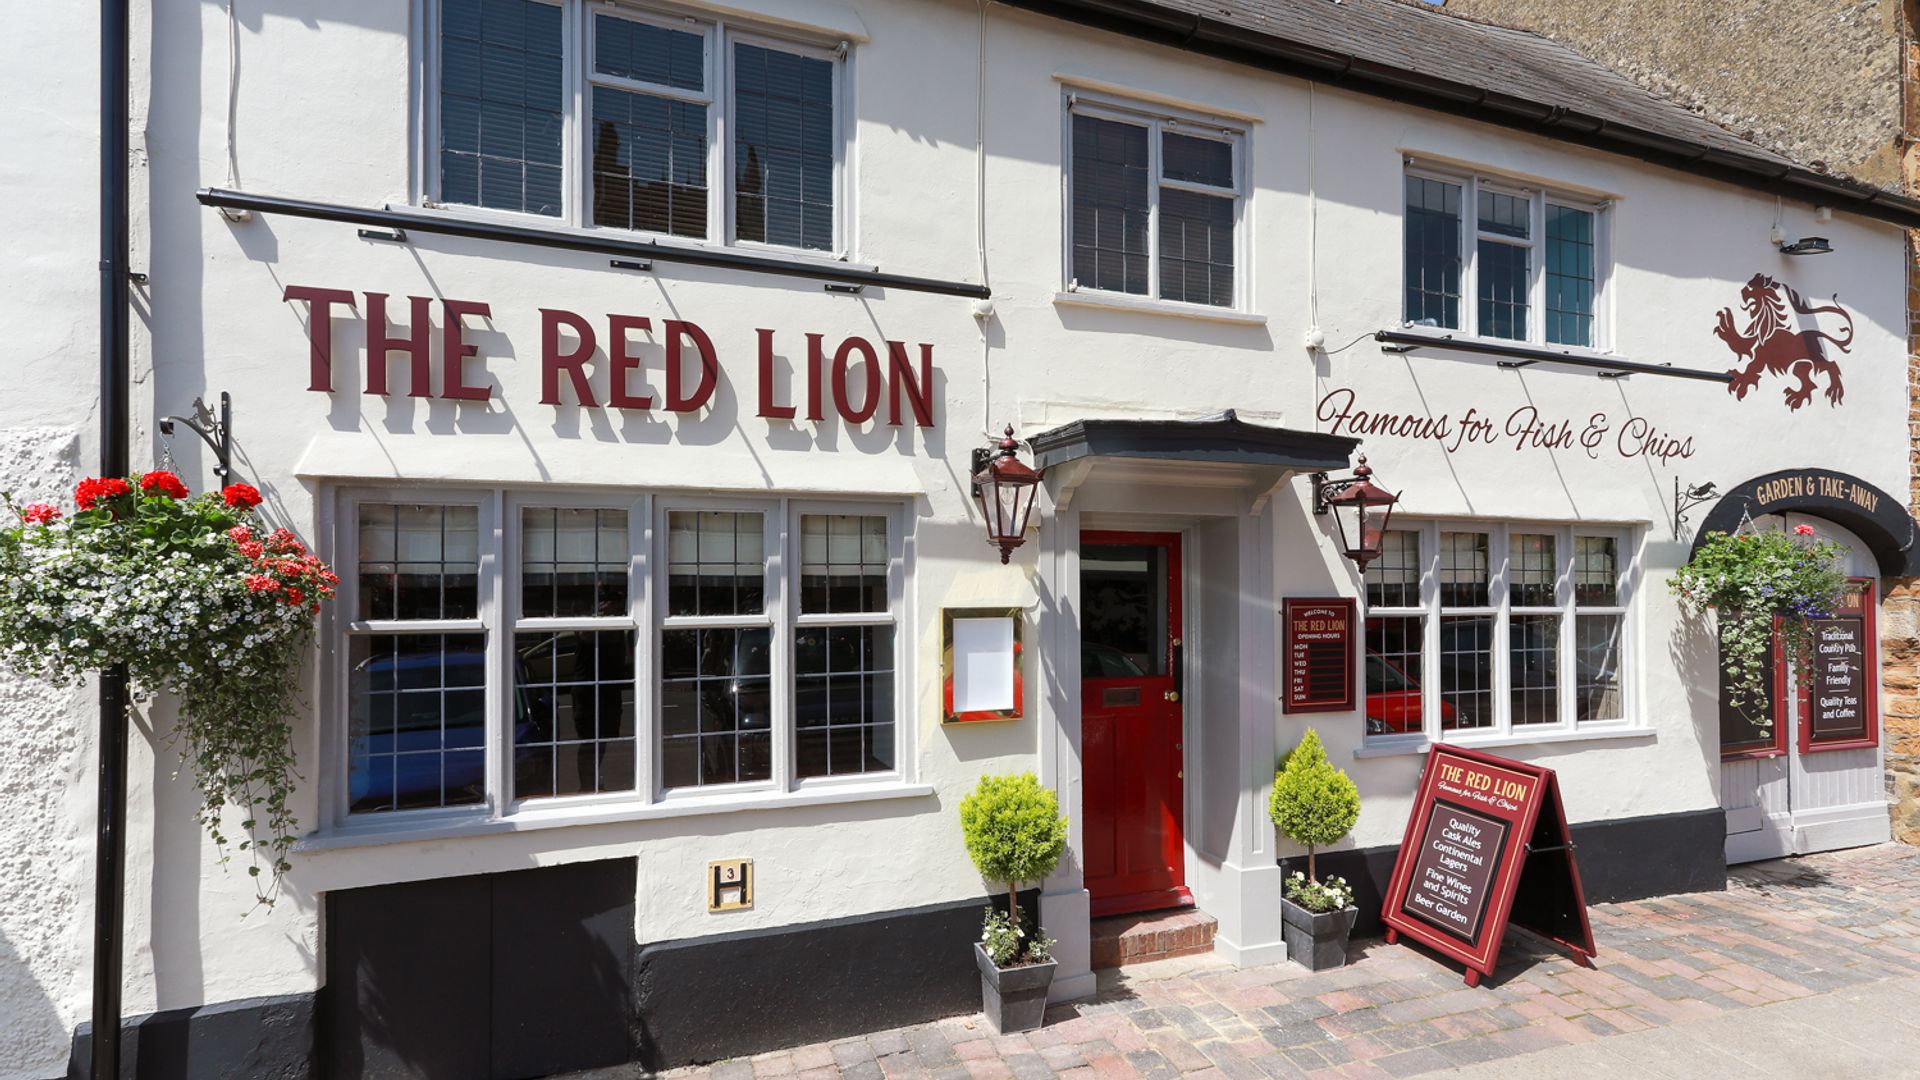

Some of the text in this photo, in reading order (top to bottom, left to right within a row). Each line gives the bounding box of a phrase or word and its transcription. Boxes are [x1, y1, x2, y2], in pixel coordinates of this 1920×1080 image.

[282, 284, 935, 428] THE RED LION
[1316, 388, 1696, 467] Famous for Fish & Chips
[1756, 476, 1879, 513] GARDEN & TAKE-AWAY
[1304, 609, 1328, 617] WELCOME
[1293, 620, 1345, 631] THE RED LION
[1821, 631, 1854, 640] Traditional
[1819, 643, 1856, 654] Country Pub
[1826, 675, 1851, 686] Friendly
[1820, 696, 1857, 707] Quality Teas
[1822, 708, 1856, 719] and Coffee
[1437, 781, 1463, 795] Famous
[1440, 763, 1527, 802] THE RED LION
[1442, 827, 1482, 849] Cask Ales
[1449, 818, 1481, 838] Quality
[1433, 840, 1483, 866] Continental
[1440, 854, 1468, 872] Lagers
[727, 867, 735, 879] 3
[1425, 867, 1472, 894] Fine Wines
[714, 863, 747, 908] H
[1423, 880, 1469, 905] and Spirits
[1414, 893, 1468, 924] Beer Garden
